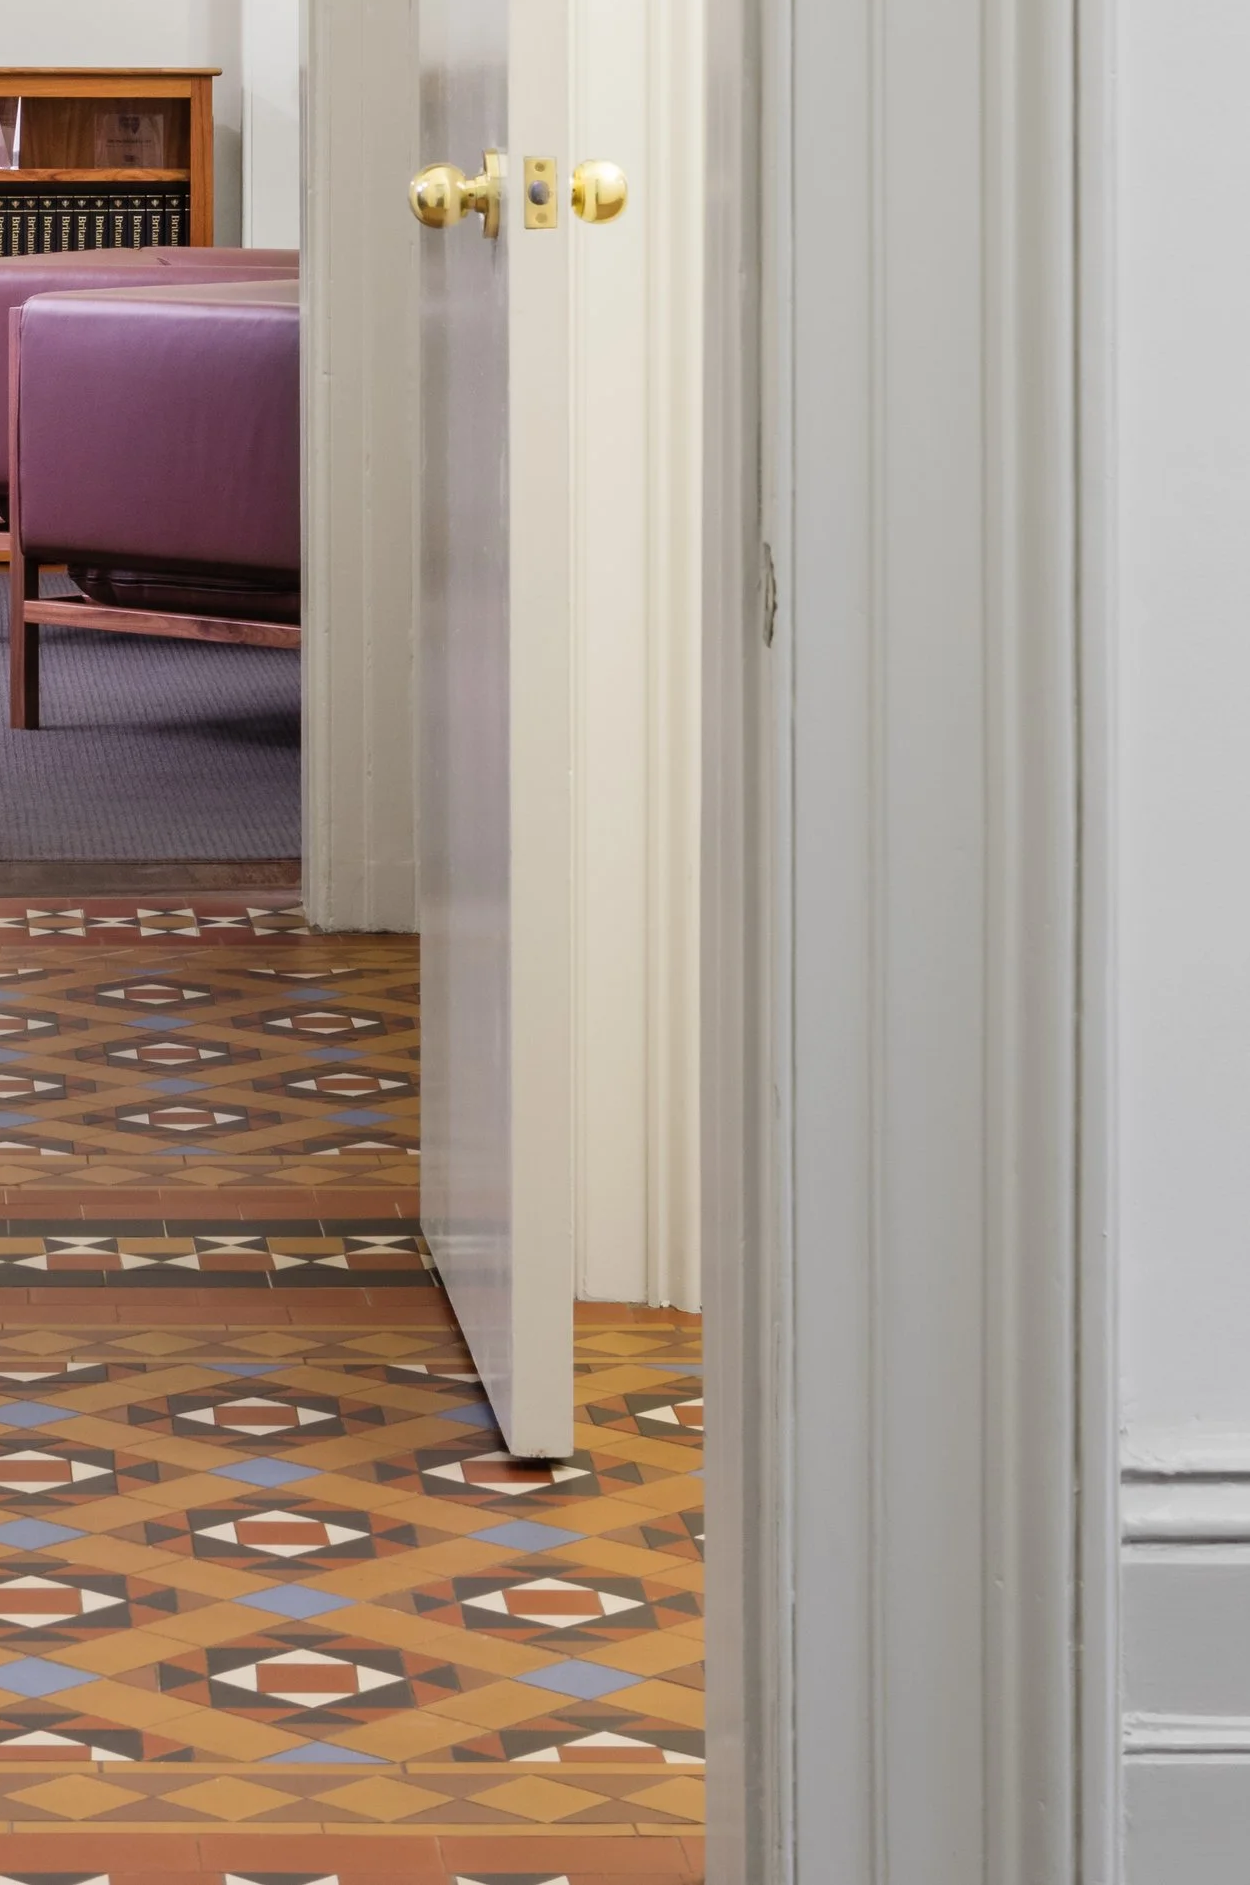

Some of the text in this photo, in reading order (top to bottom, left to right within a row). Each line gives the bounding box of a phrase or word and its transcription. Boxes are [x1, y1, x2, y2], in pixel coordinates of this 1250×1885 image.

[28, 217, 36, 253] Britanni
[62, 217, 70, 251] Britann
[78, 217, 86, 250] Britann
[96, 217, 104, 248] Britann
[134, 216, 142, 249] Britann
